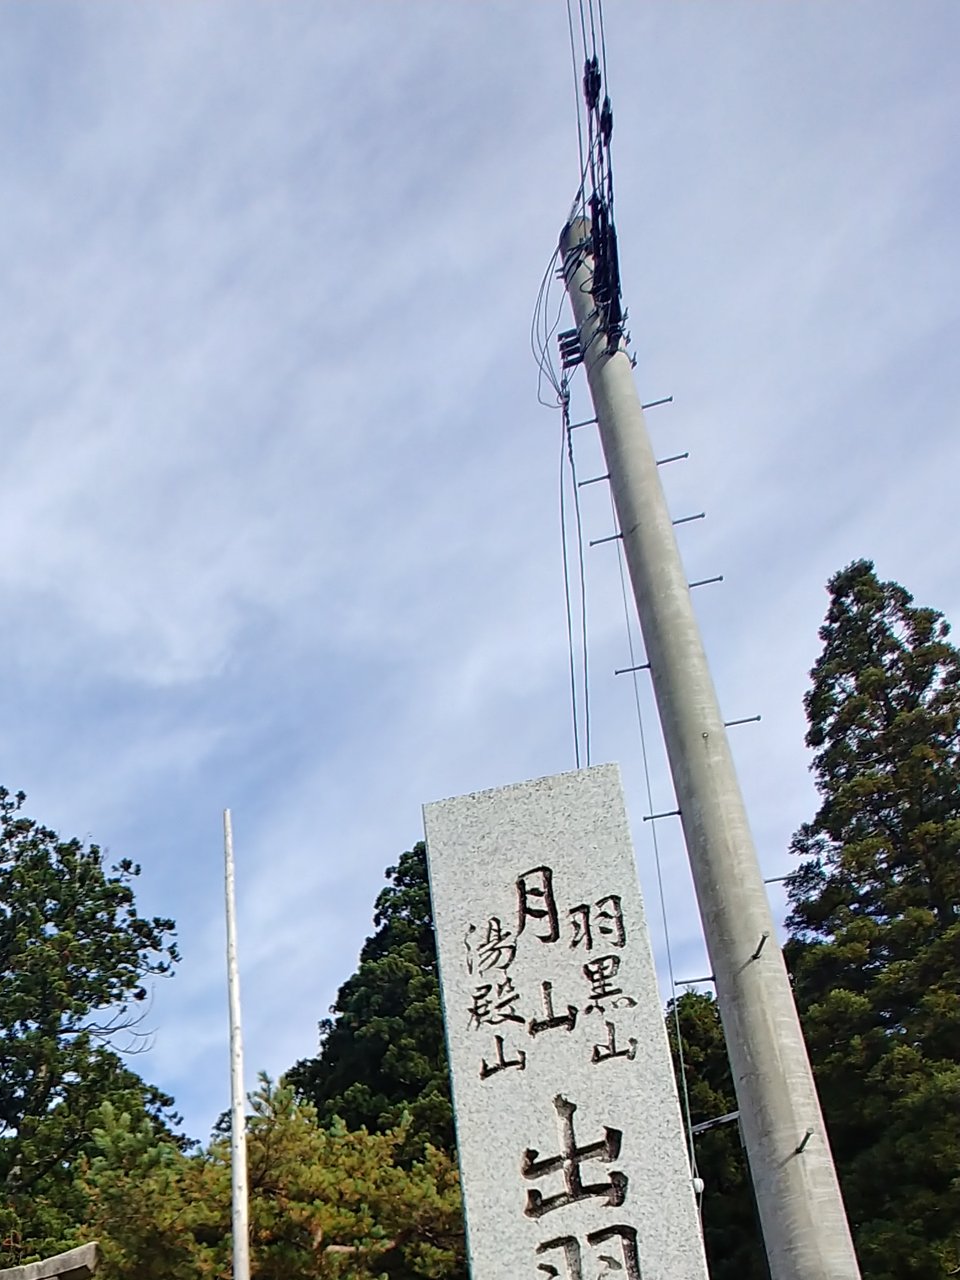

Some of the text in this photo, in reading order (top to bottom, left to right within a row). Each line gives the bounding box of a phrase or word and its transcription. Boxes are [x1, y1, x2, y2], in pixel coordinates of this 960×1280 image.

[463, 916, 527, 1081] 湯殿山
[515, 865, 578, 1038] 月山
[567, 893, 639, 1066] 羽黒山
